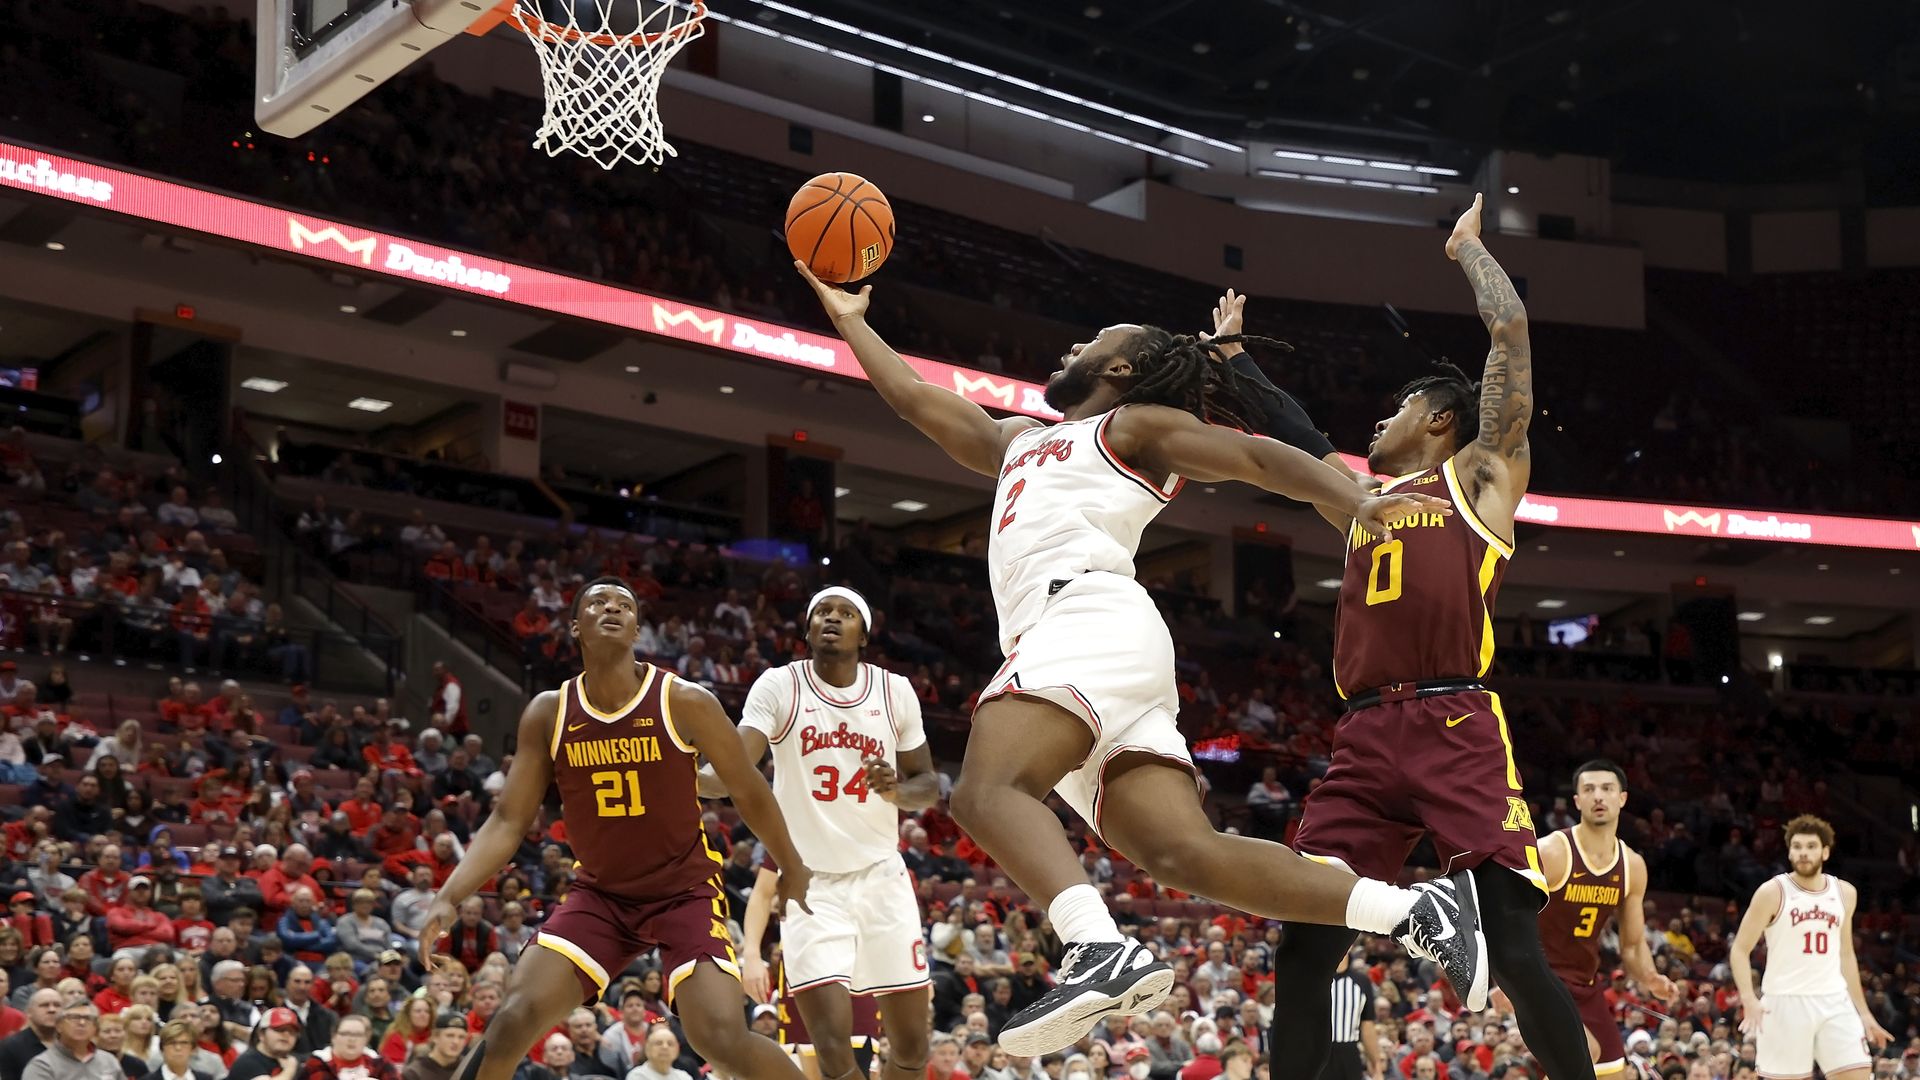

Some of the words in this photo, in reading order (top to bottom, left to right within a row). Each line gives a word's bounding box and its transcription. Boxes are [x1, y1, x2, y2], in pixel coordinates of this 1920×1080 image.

[0, 158, 112, 201] uchess
[385, 243, 511, 293] Duchess
[732, 322, 835, 367] Duchess
[998, 478, 1026, 535] 2
[1728, 514, 1811, 539] Duchess
[1365, 539, 1403, 606] 0
[565, 736, 662, 767] MINNESOTA
[801, 722, 885, 764] Buckeyes
[591, 770, 646, 817] 21
[812, 765, 869, 803] 34
[1564, 883, 1620, 906] MINNESOTA
[1573, 907, 1599, 937] 3
[1803, 931, 1828, 954] 10
